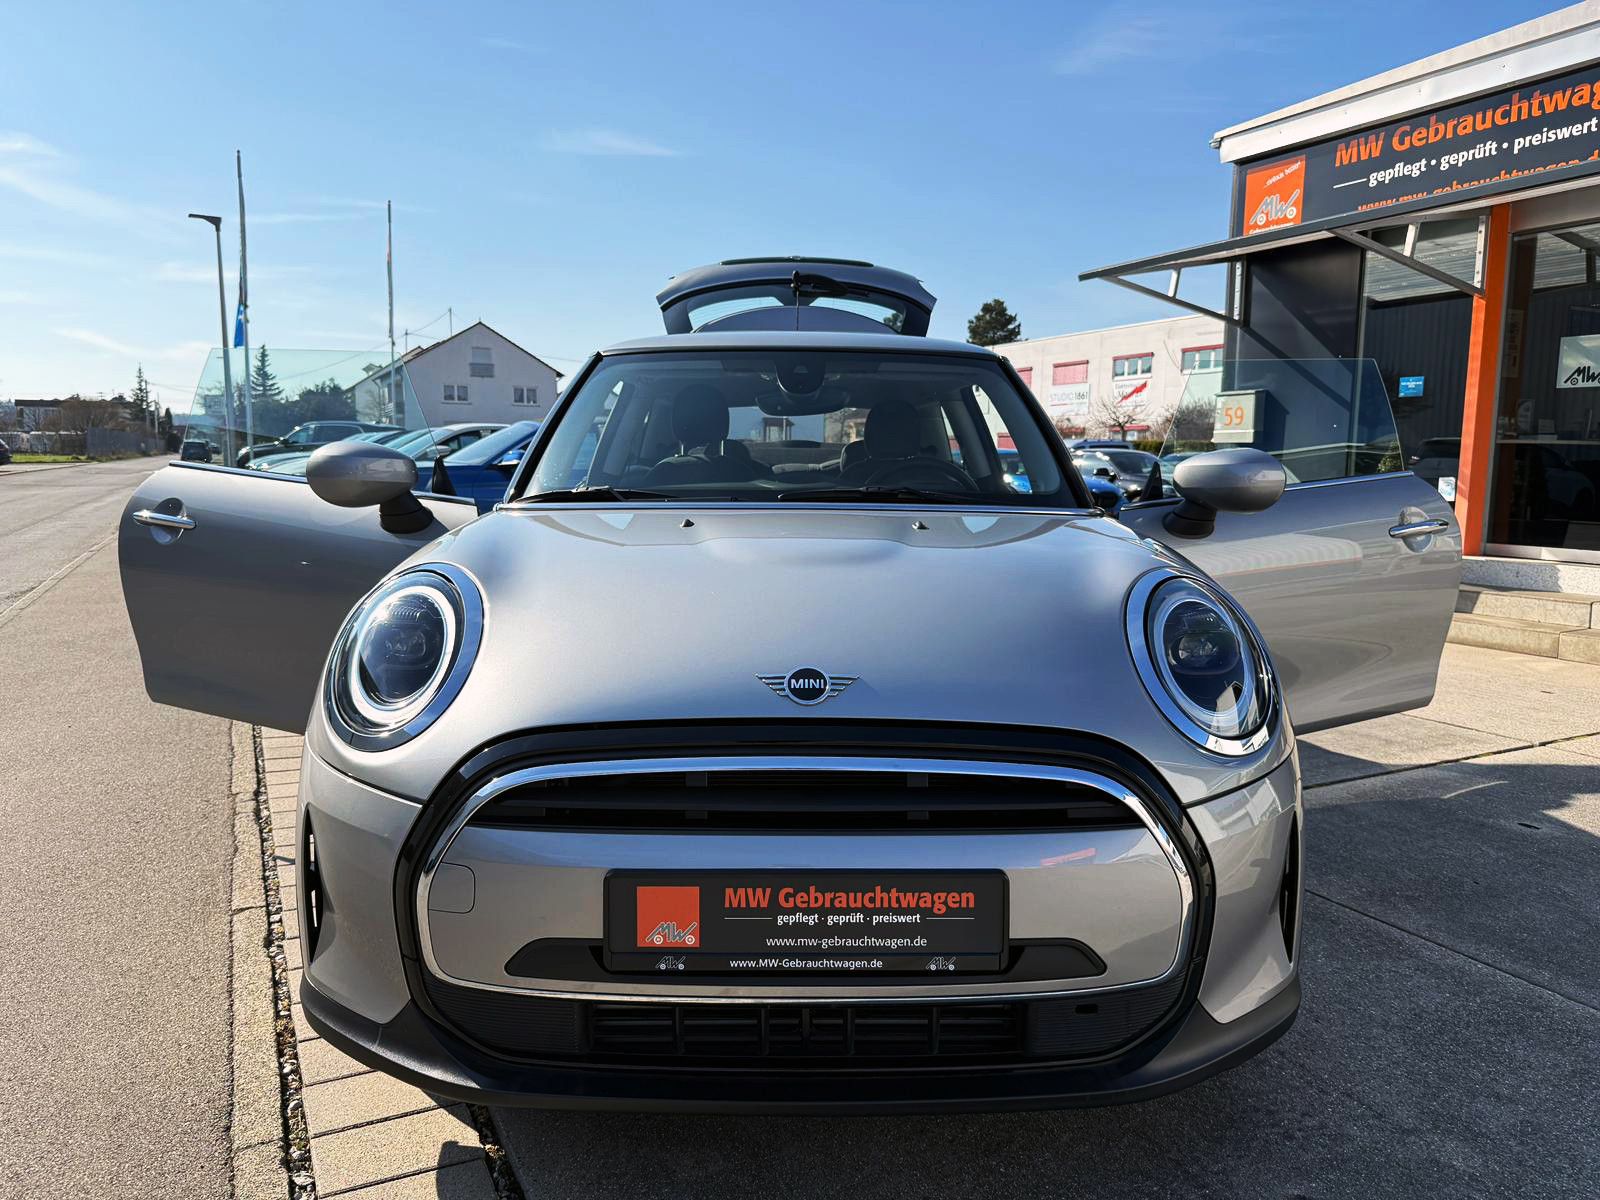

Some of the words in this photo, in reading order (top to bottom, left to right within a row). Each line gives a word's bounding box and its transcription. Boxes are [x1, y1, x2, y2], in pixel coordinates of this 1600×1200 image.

[1335, 132, 1385, 167] MW
[1368, 160, 1427, 187] gepflegt
[1440, 141, 1498, 171] geprüft
[1513, 117, 1599, 154] preiswert
[1223, 405, 1245, 427] 59
[790, 679, 824, 689] MINI
[724, 888, 771, 908] MW
[778, 885, 975, 915] Gebrauchtwagen
[777, 912, 819, 925] gepflegt
[827, 912, 864, 925] geprüft
[872, 912, 921, 925] preiswert
[766, 935, 927, 949] www.mw-gebrauchtwagen.de
[729, 958, 883, 969] www.MW-Gebrauchtwagen.de
